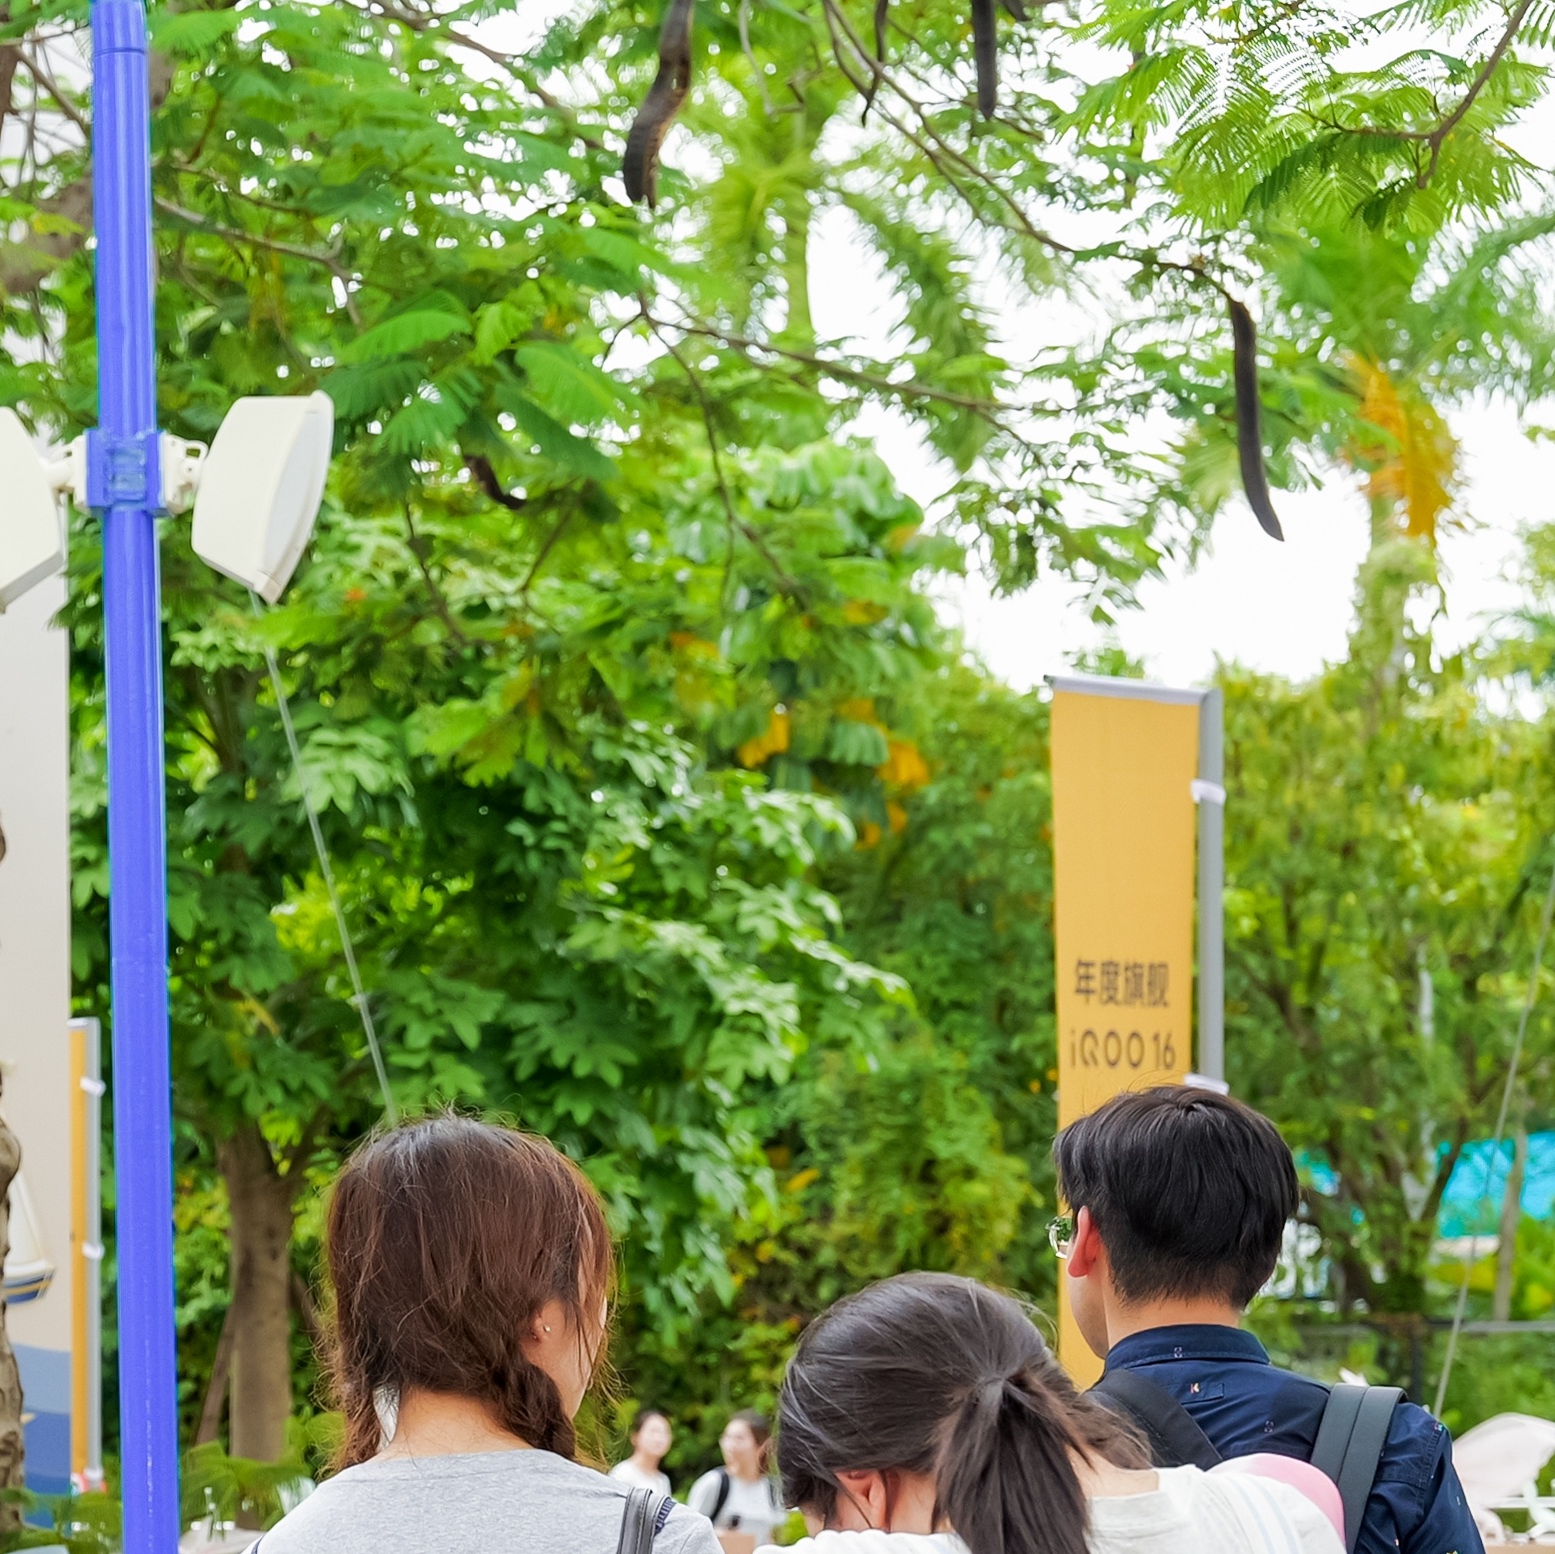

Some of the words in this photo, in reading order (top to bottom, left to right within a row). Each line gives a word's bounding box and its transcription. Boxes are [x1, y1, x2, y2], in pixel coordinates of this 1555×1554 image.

[1074, 958, 1170, 1007] 年度旗舰
[1070, 1028, 1145, 1070] iQOO
[1152, 1030, 1177, 1071] 16
